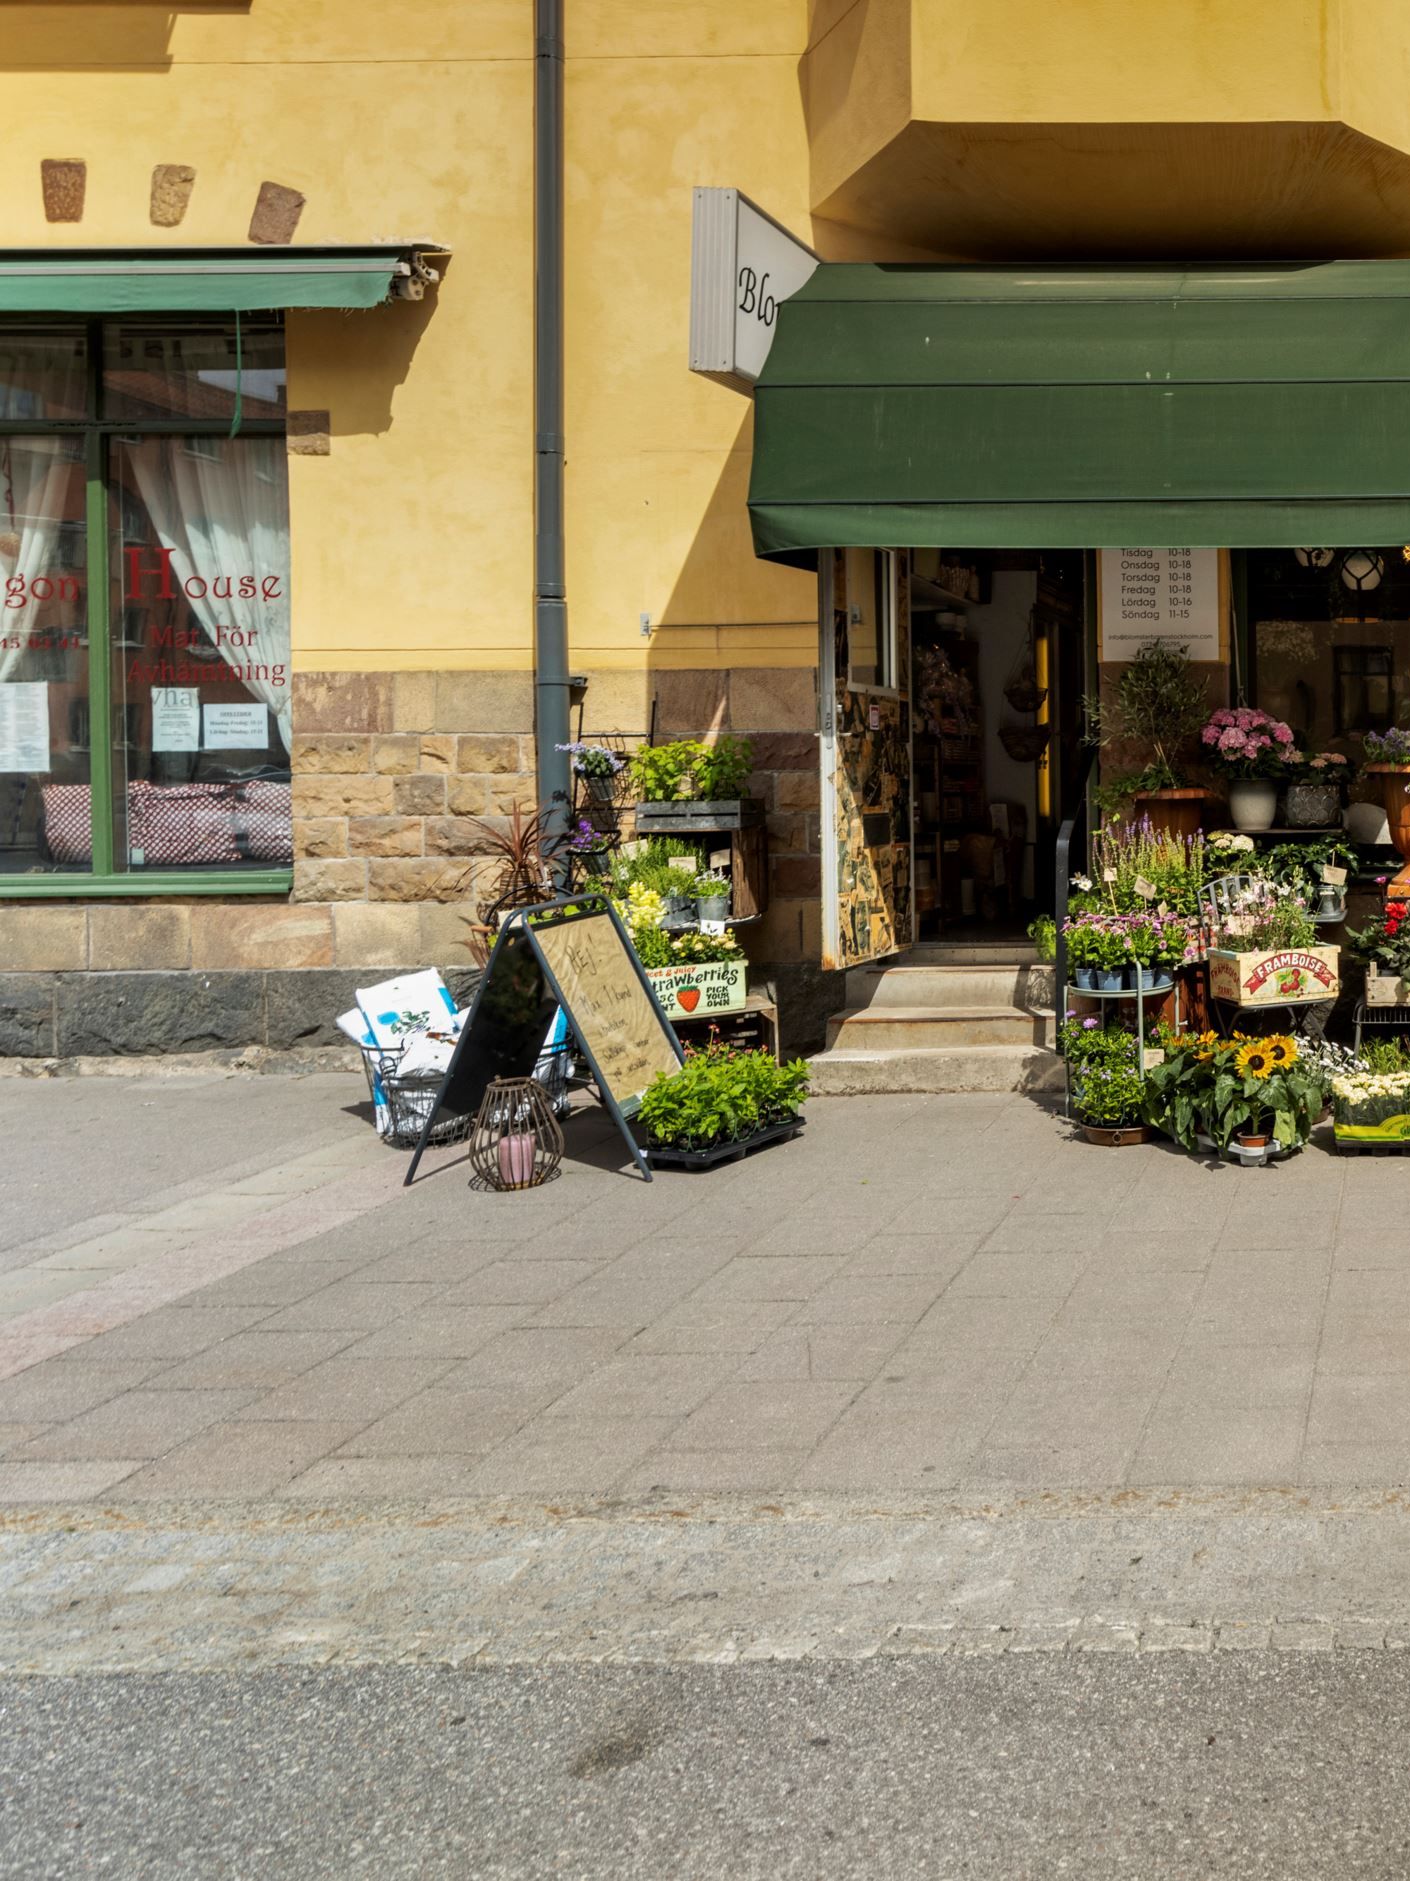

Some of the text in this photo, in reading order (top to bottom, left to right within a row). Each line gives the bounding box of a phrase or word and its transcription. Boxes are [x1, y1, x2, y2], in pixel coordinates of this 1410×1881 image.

[1121, 547, 1191, 559] Tisdag 10-18
[1121, 560, 1192, 571] Onsdag 10-18
[123, 547, 282, 602] House
[1121, 572, 1192, 583] Torsdag 10-18
[1121, 584, 1192, 595] Fredag 10-18
[1121, 597, 1192, 608] Lördag 10-16
[1121, 609, 1190, 620] Söndag 11-15
[151, 625, 259, 647] Mat För
[127, 659, 287, 687] Avhämtning
[1256, 953, 1323, 979] FRAMBOISE
[652, 967, 739, 994] trawberries
[706, 985, 728, 994] PICK
[706, 992, 730, 1000] YOUR
[706, 999, 730, 1007] OWN
